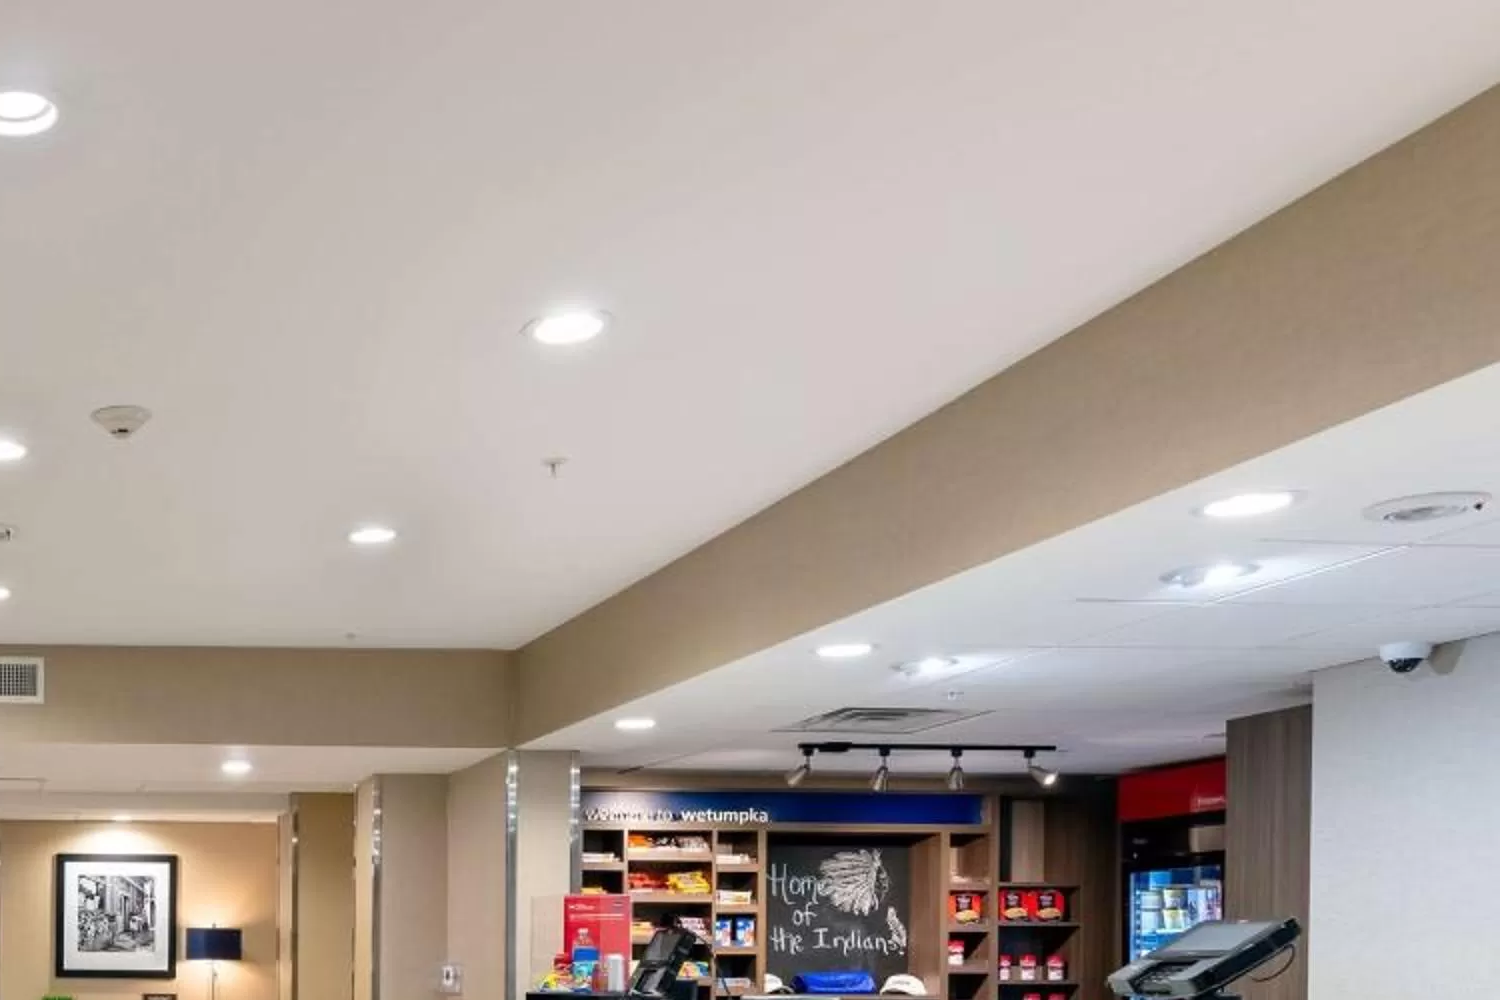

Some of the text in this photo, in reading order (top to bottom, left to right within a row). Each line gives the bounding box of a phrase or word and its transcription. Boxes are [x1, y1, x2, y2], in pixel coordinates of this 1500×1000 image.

[681, 807, 770, 824] wetumpka
[766, 863, 830, 905] Home
[792, 902, 817, 926] of
